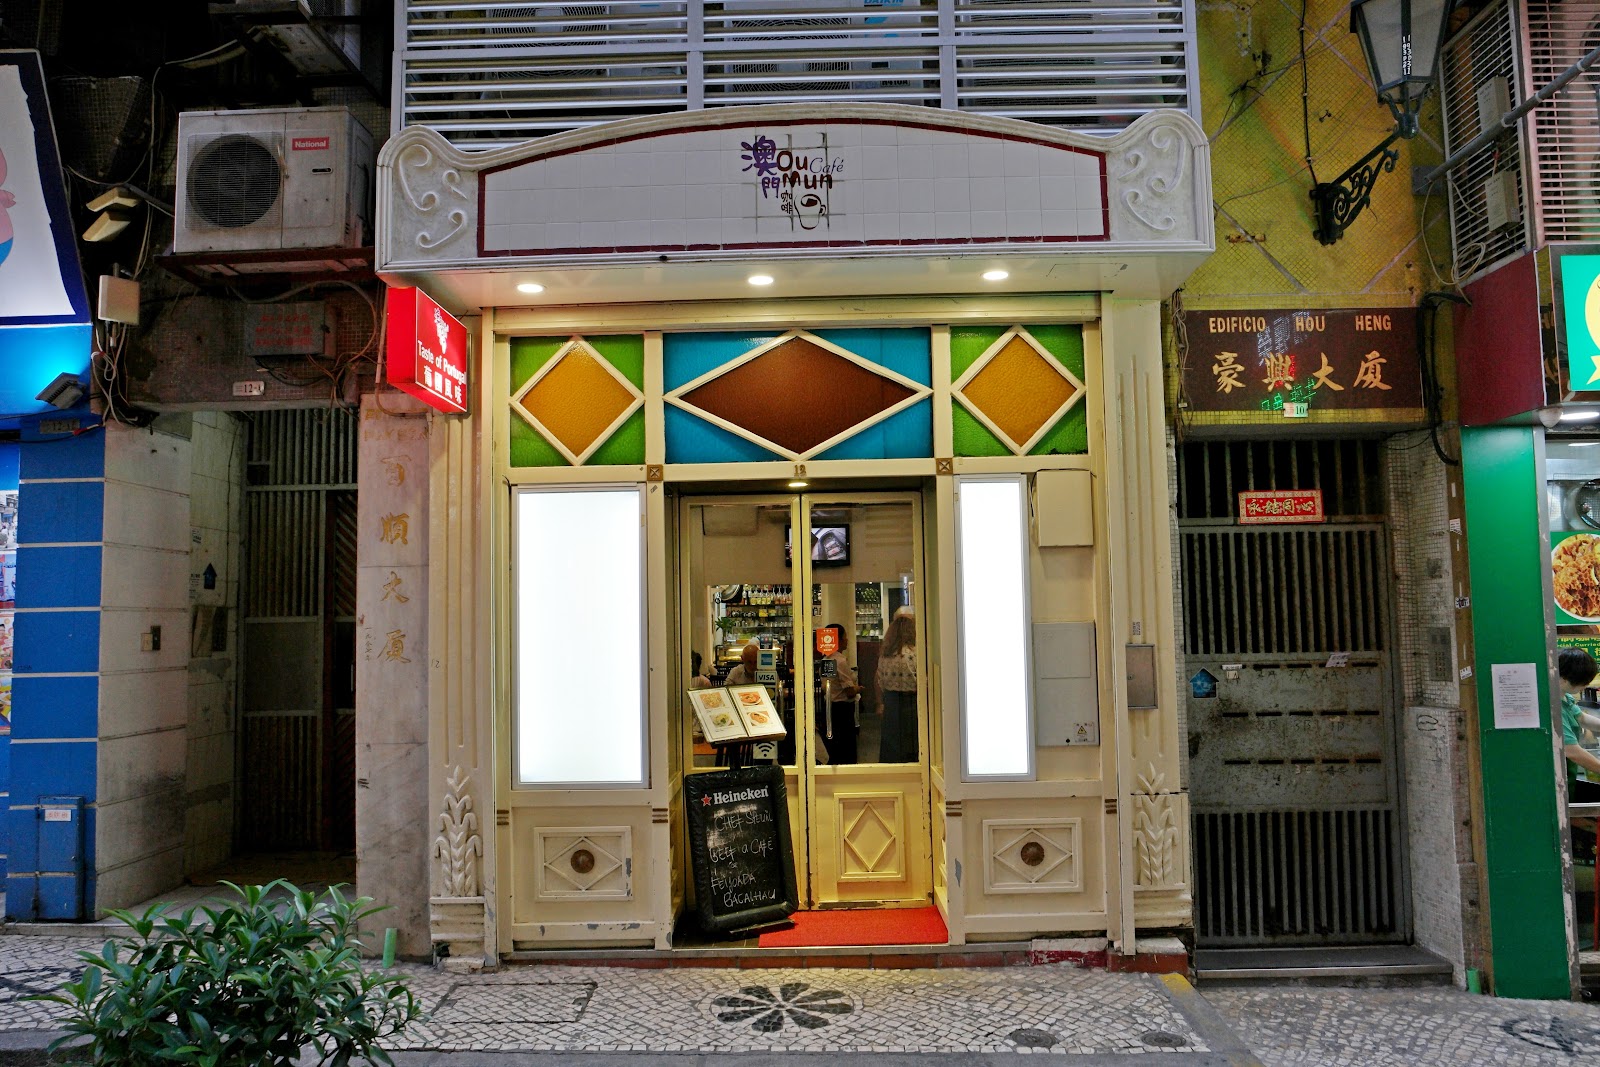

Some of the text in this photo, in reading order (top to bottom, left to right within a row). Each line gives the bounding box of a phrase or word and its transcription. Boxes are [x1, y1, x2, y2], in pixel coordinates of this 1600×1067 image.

[295, 140, 327, 148] National
[776, 150, 844, 175] Ou Café
[1208, 314, 1392, 333] EDIFICIO HOU HENG
[418, 340, 467, 385] Taste of Portugal
[1296, 405, 1305, 415] 10
[713, 788, 769, 805] Heineken
[714, 815, 744, 832] CHEF
[709, 845, 737, 863] BEEF
